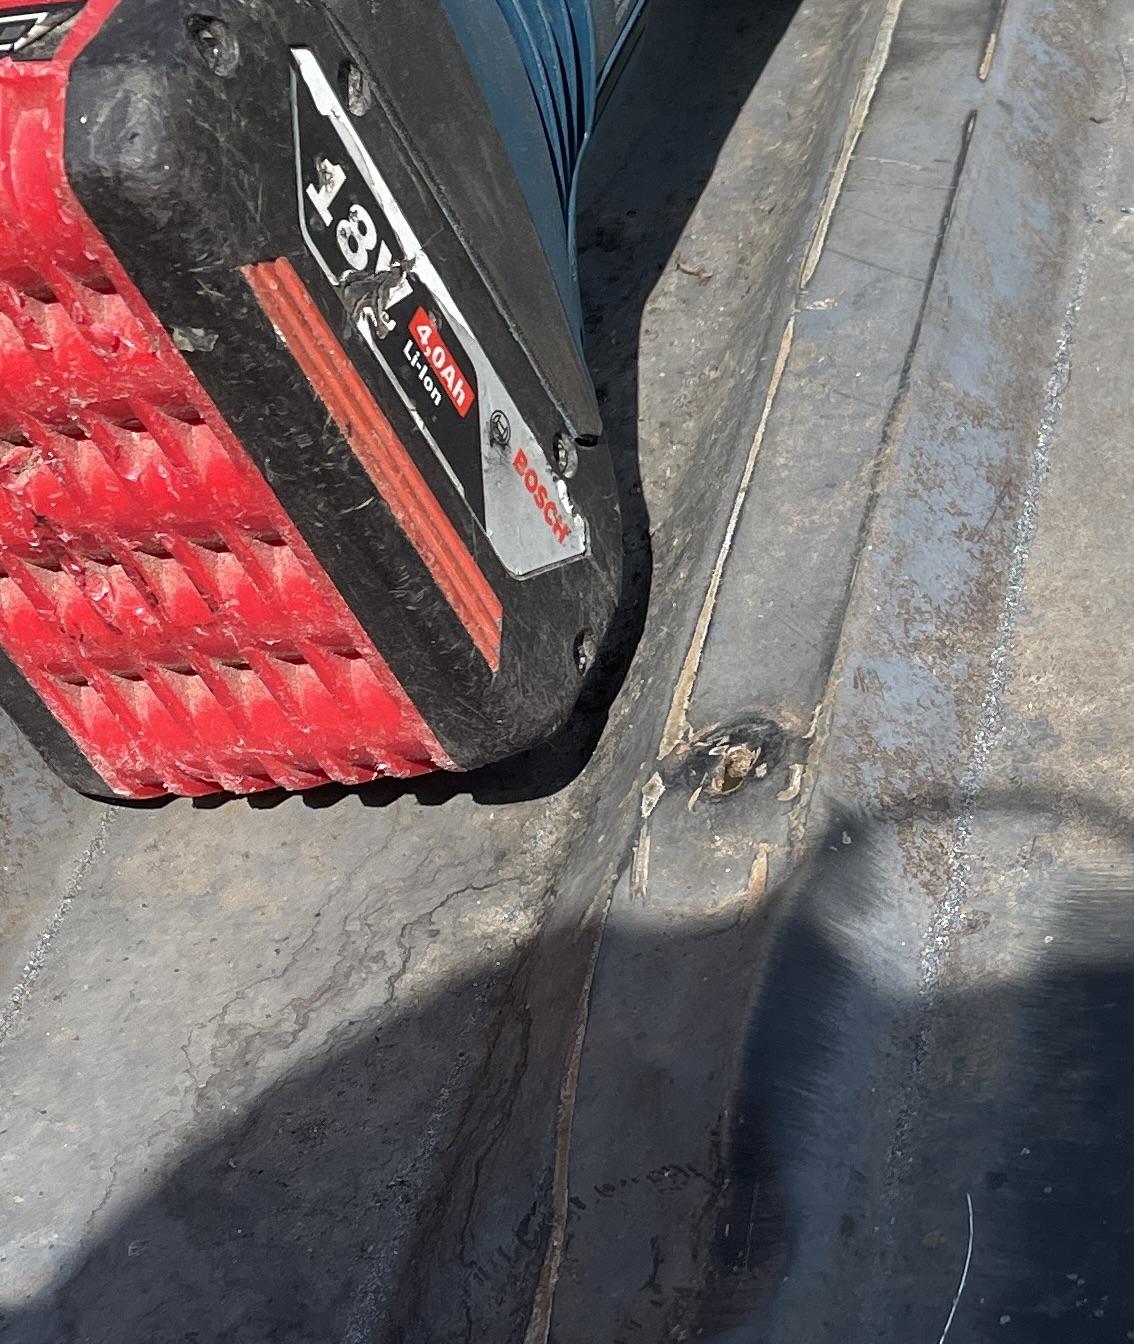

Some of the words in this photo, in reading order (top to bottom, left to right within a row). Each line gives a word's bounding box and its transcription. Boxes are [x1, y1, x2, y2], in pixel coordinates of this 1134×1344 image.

[403, 339, 442, 407] Li-Ion
[415, 323, 468, 408] 4,0Ah
[512, 448, 571, 544] BOSCH
